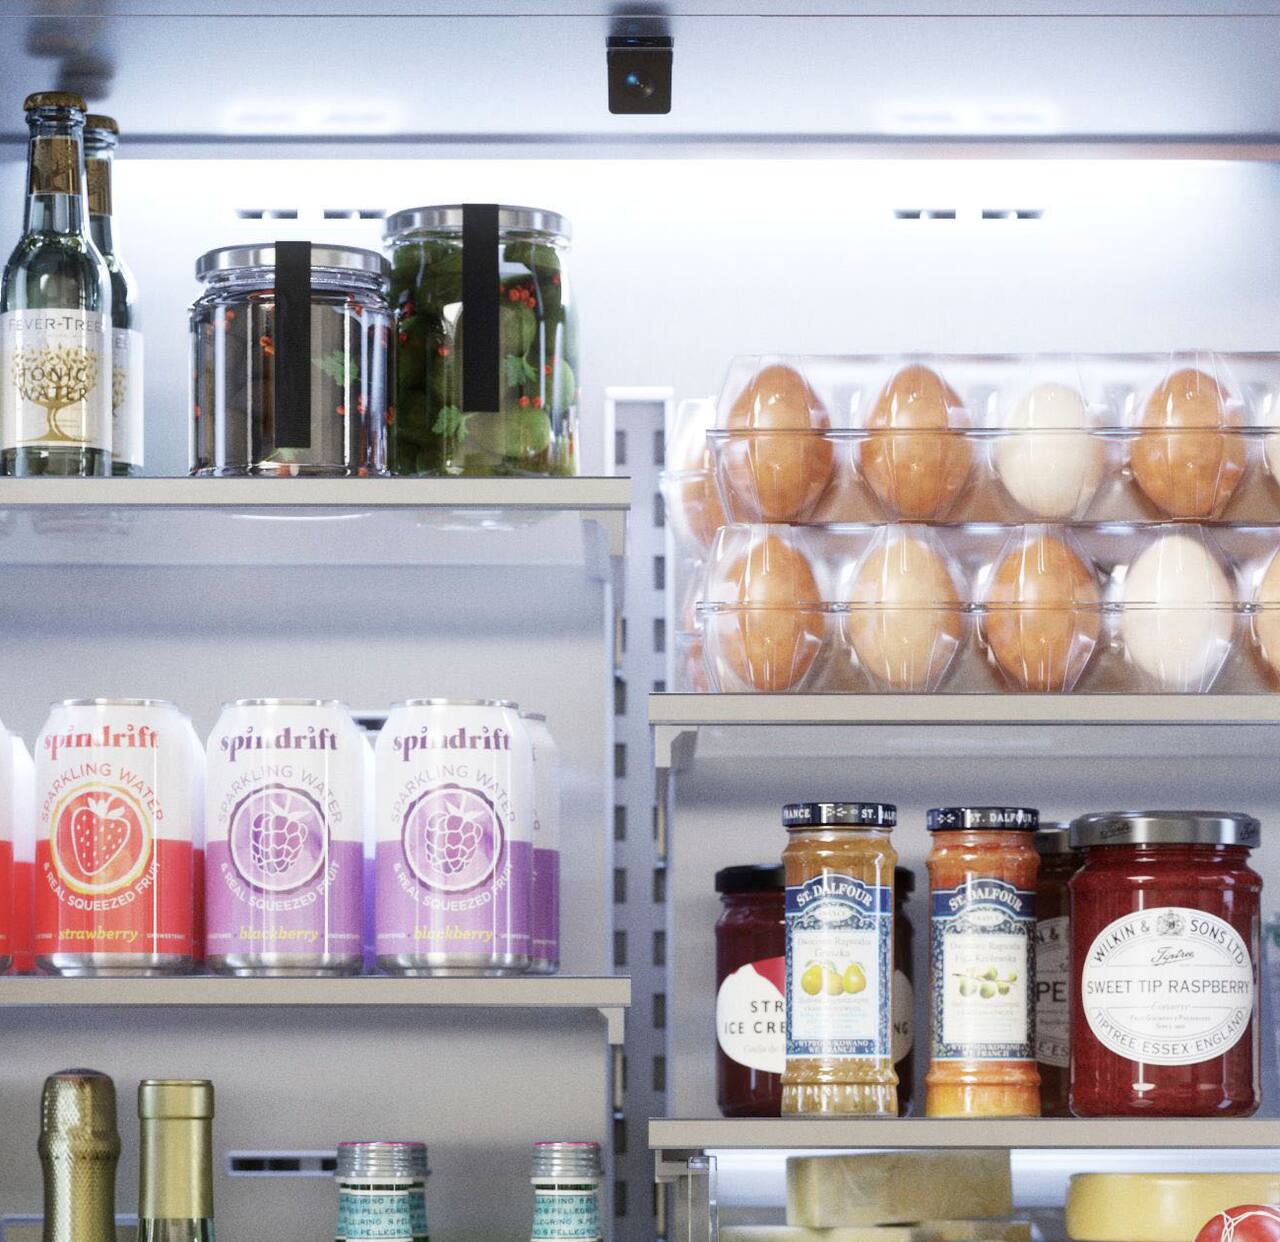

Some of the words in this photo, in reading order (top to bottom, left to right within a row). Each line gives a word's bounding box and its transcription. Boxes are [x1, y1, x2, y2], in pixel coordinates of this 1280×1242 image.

[8, 316, 104, 332] FEVER-TREE
[21, 367, 88, 383] TONIC
[20, 386, 89, 402] WATER
[44, 724, 160, 761] spindrift
[220, 726, 337, 762] spindrift
[41, 762, 112, 823] SPARKLING
[119, 767, 165, 821] WATER
[218, 765, 293, 823] SPARKLING
[391, 765, 468, 823] SPARKLING
[783, 808, 812, 819] RANCE
[46, 873, 66, 902] REAL
[67, 890, 136, 912] SQUEEZED
[224, 873, 247, 902] REAL
[248, 890, 317, 912] SQUEEZED
[422, 890, 492, 912] SQUEEZED
[796, 891, 813, 907] ST.
[813, 882, 873, 907] DALFOUR
[969, 887, 1023, 912] DALFOUR
[59, 925, 139, 943] strawberry
[1094, 922, 1135, 963] WILKIN
[1140, 919, 1150, 932] &
[1190, 919, 1225, 944] SONS
[1150, 946, 1195, 965] Tiptree
[1087, 980, 1133, 995] SWEET
[1139, 980, 1163, 994] TIP
[1168, 980, 1250, 995] RASPBERRY
[724, 1021, 745, 1035] ICE
[753, 1020, 786, 1035] CRE
[1094, 1010, 1137, 1049] TIPTREE
[1142, 1040, 1190, 1054] ESSEX
[1196, 1009, 1245, 1052] ENGLAND
